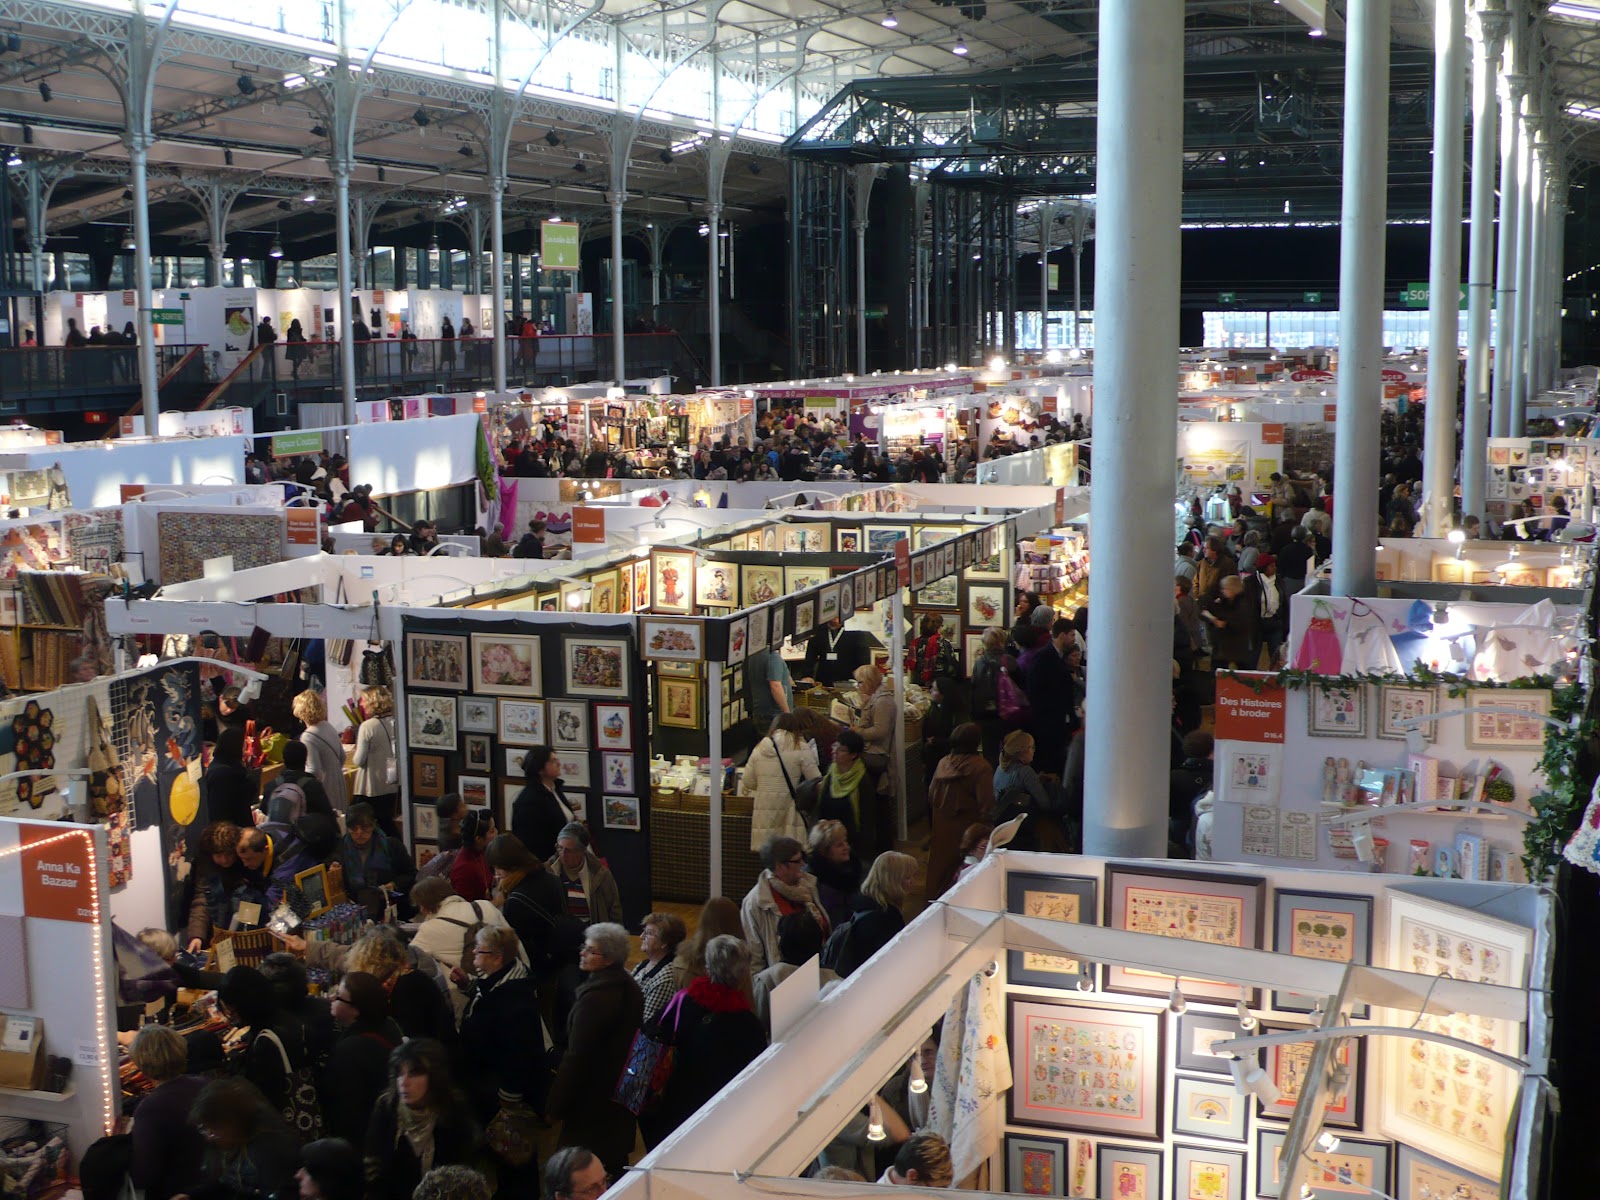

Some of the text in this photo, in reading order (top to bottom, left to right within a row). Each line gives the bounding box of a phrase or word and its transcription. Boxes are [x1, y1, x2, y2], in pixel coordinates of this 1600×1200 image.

[161, 312, 183, 320] SORTIE
[1220, 696, 1283, 709] Des Histoires
[1230, 708, 1272, 718] à broder
[36, 860, 81, 874] Anna Ka
[41, 874, 78, 888] Bazaar
